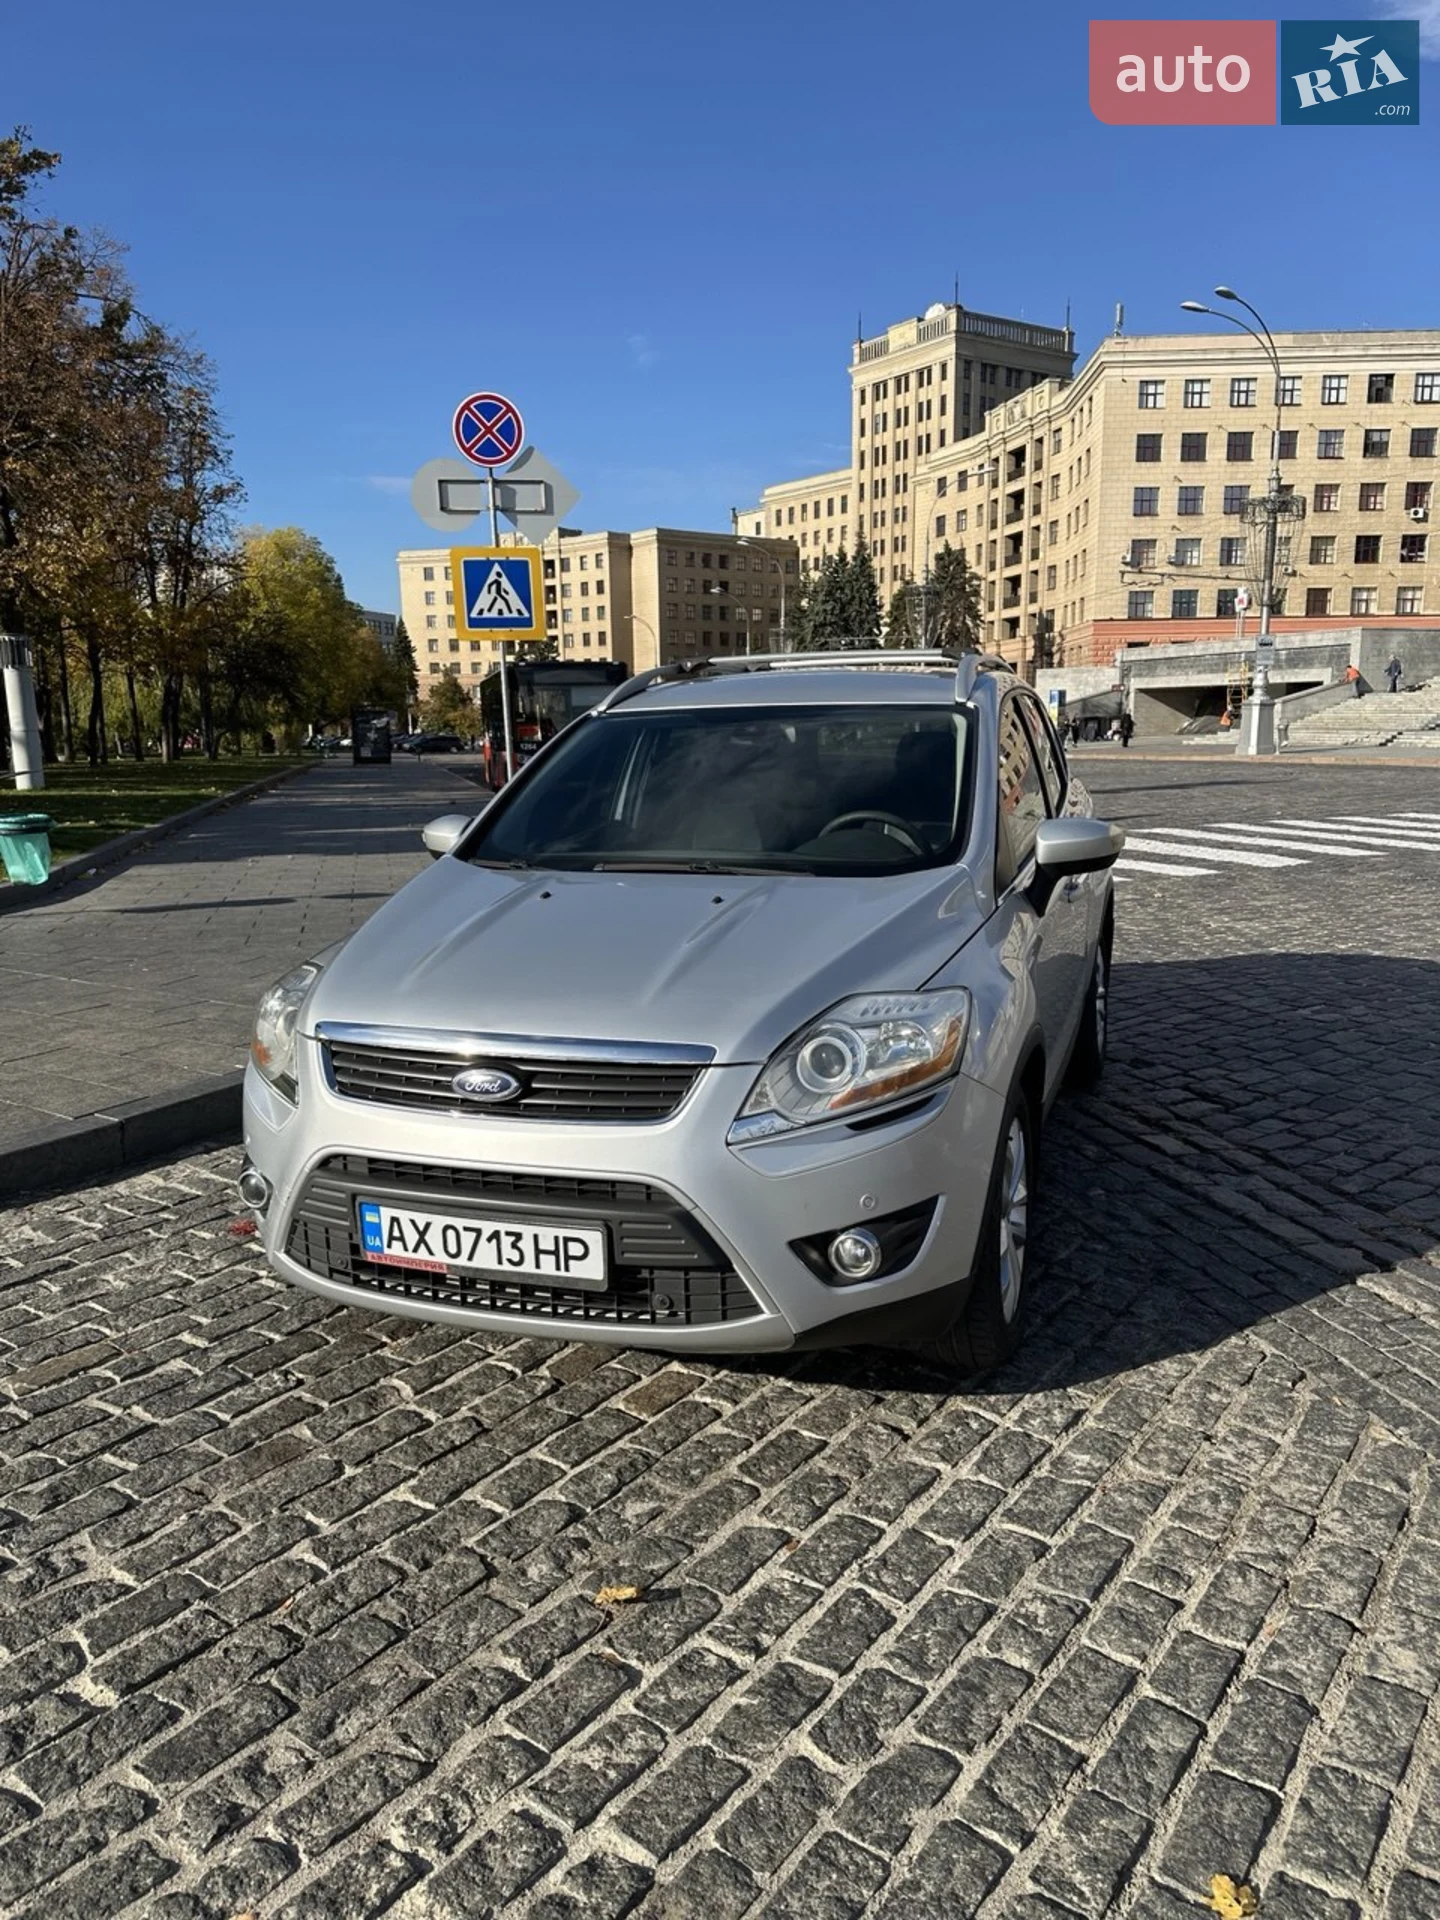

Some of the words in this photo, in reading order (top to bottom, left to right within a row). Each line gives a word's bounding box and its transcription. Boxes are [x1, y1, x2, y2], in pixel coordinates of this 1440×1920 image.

[464, 1079, 501, 1092] Ford
[366, 1235, 382, 1248] UA
[386, 1216, 435, 1256] AX
[441, 1224, 525, 1267] 0713
[533, 1233, 590, 1272] HP
[370, 1254, 445, 1271] АВТОИМПЕРИЯ
